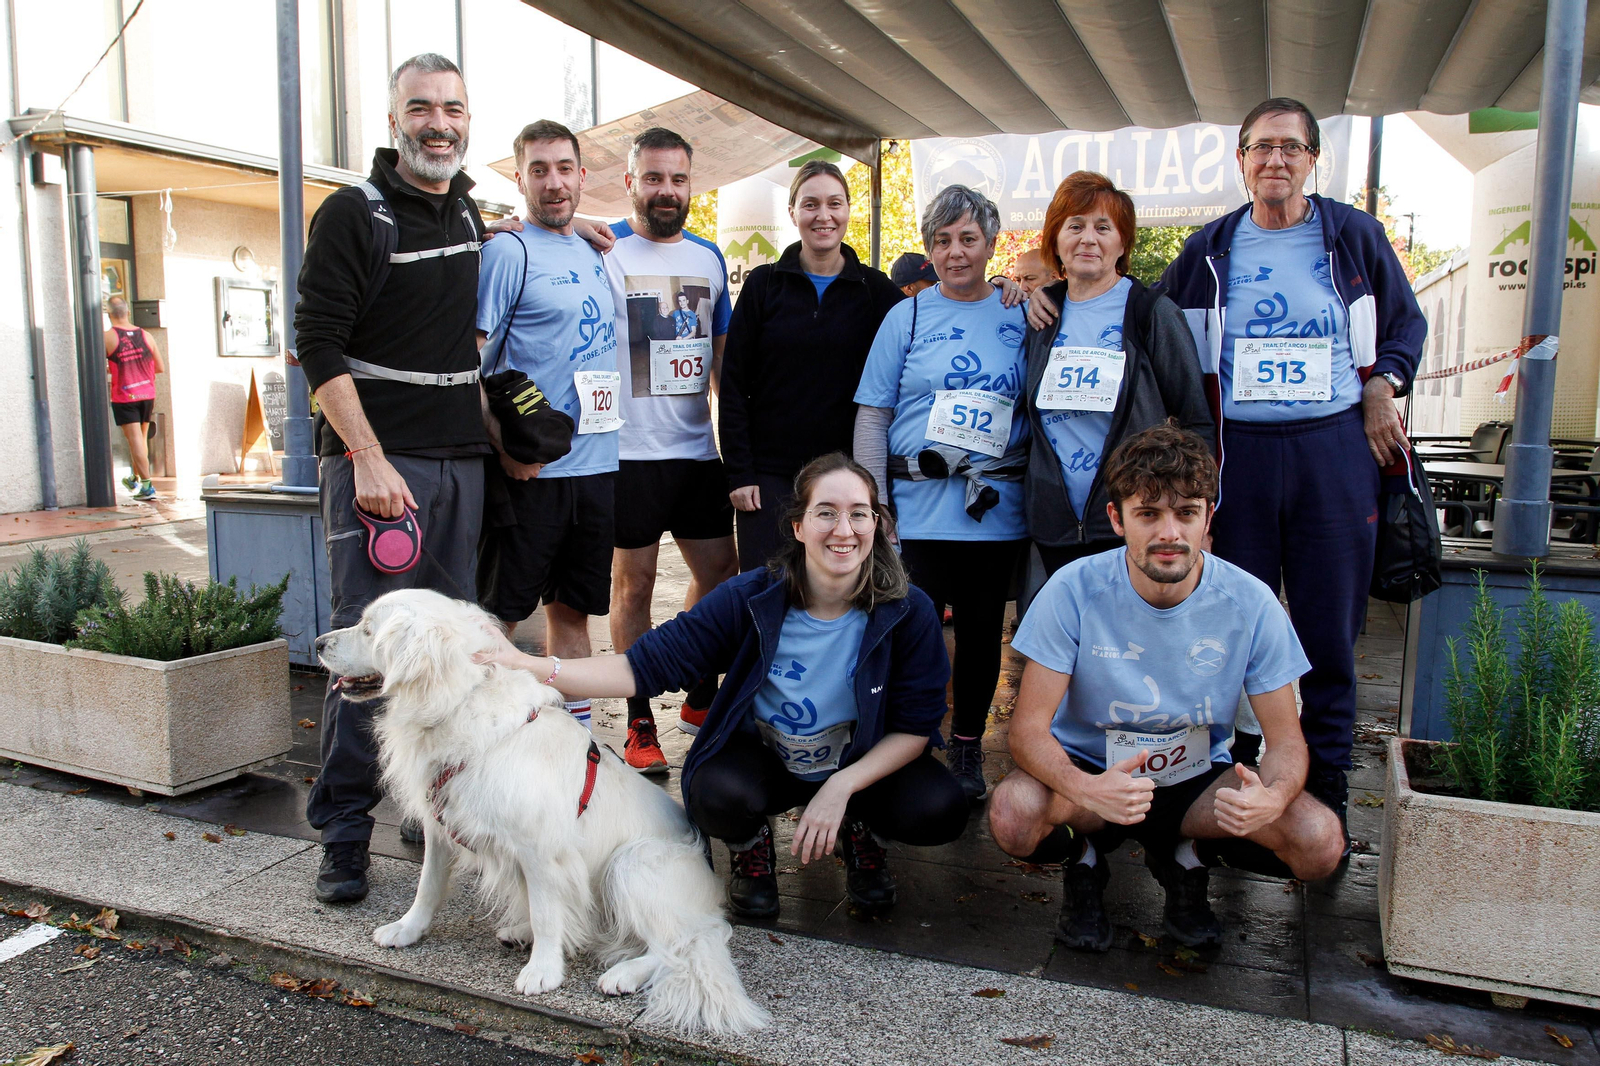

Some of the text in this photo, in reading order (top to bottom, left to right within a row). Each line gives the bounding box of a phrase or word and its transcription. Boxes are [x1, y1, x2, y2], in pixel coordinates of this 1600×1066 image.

[670, 356, 704, 378] 103
[1058, 366, 1100, 389] 514
[1256, 360, 1306, 384] 513
[592, 390, 612, 411] 120
[950, 404, 992, 434] 512
[1046, 412, 1070, 426] JOSE
[1168, 730, 1188, 742] ARCOS
[776, 740, 832, 764] 529
